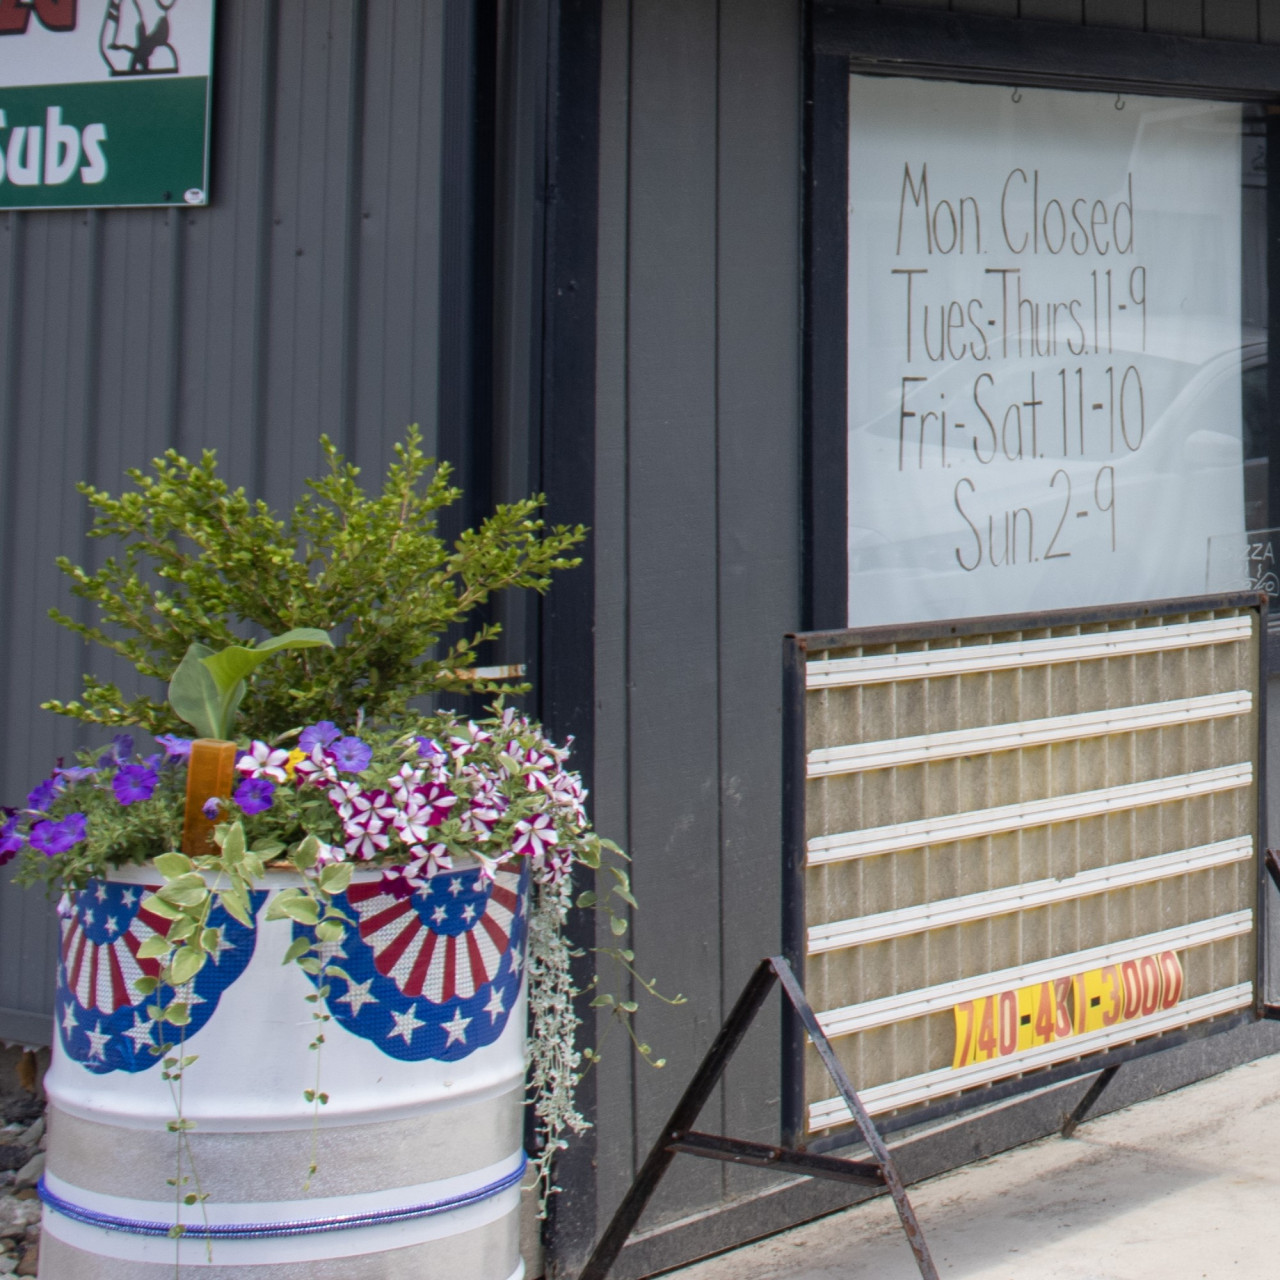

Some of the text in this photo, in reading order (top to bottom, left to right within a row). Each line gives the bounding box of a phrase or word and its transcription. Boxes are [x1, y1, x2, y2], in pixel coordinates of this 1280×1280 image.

[0, 106, 108, 186] ubs
[1001, 168, 1134, 256] Closed
[1091, 266, 1146, 355] 11-9
[1058, 365, 1144, 457] 11-10
[1044, 466, 1115, 560] 2-9
[958, 950, 1182, 1068] 740-481-3000
